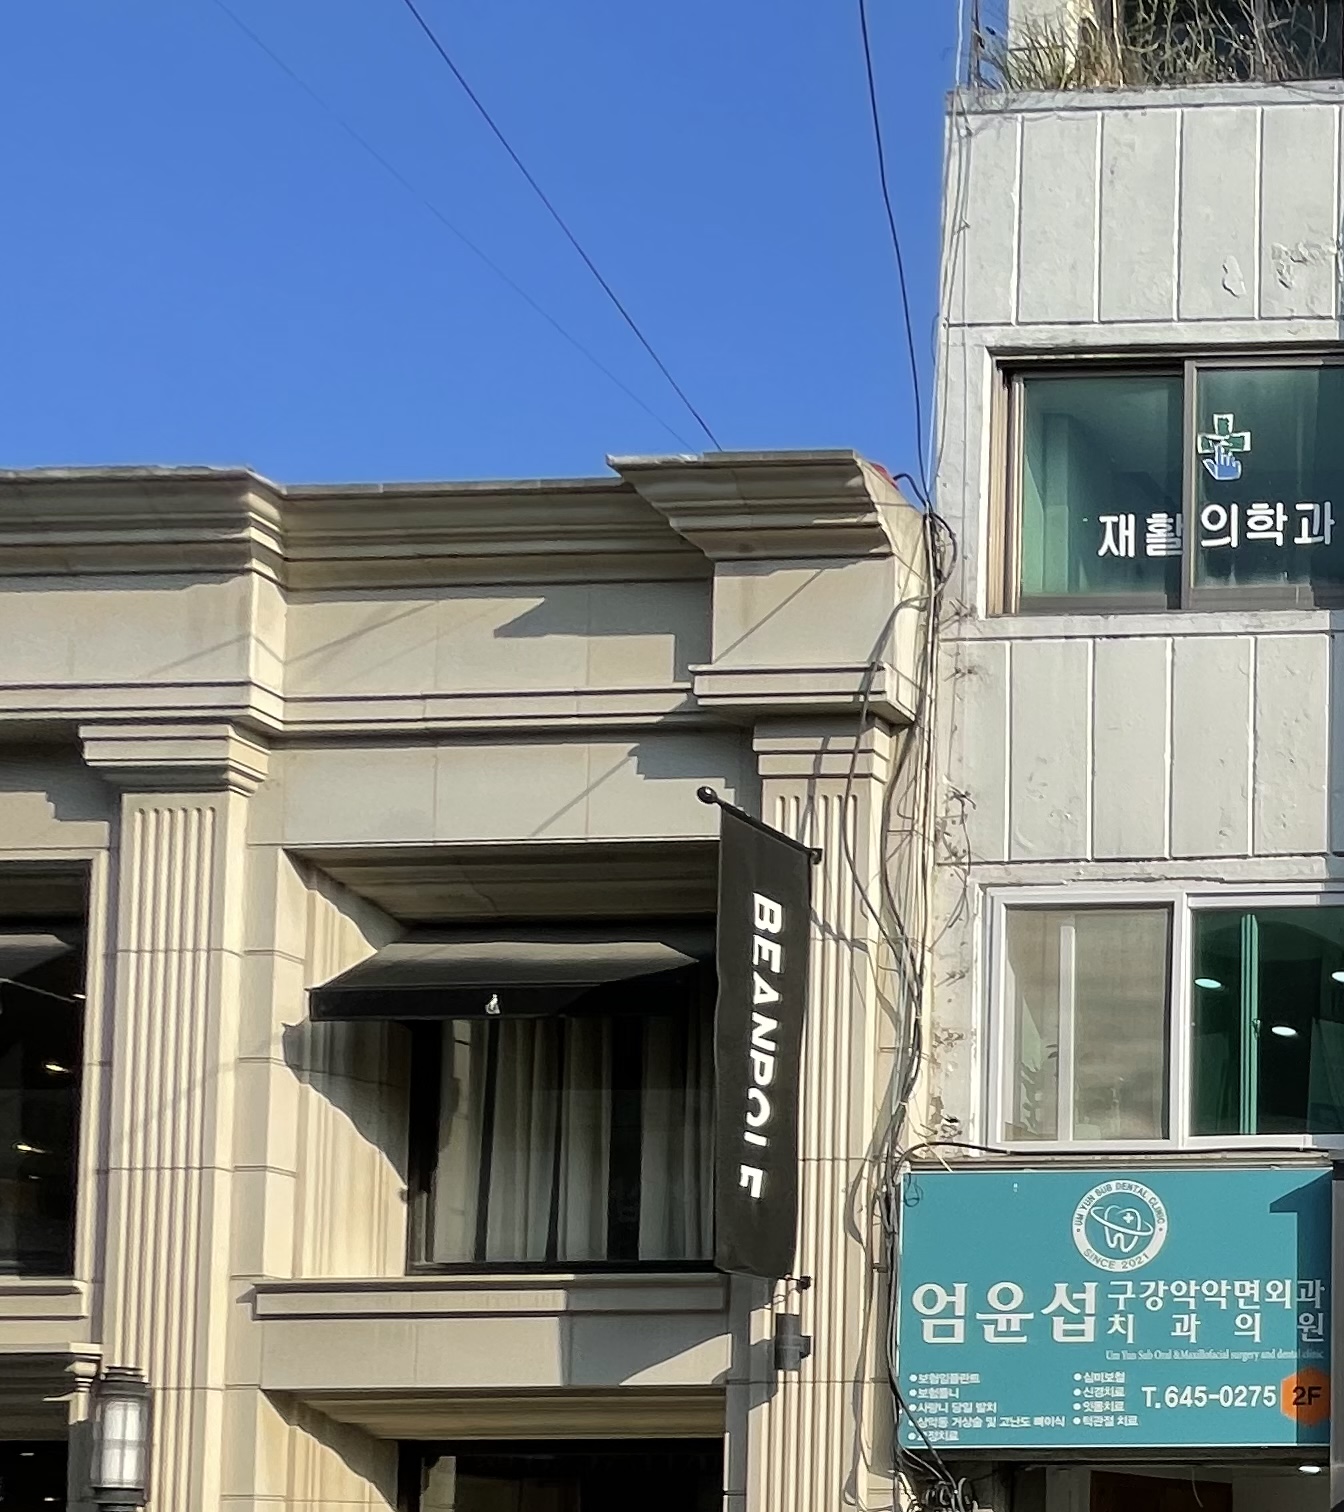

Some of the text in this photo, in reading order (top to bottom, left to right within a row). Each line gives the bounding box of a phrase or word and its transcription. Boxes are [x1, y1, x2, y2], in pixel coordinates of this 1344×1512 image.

[1097, 501, 1336, 558] 재활의학과
[1115, 1182, 1148, 1198] DENTAL
[1148, 1198, 1165, 1223] CLINIC
[1083, 1249, 1149, 1269] SINCE 2021
[911, 1280, 1099, 1345] 엄윤섭
[1106, 1312, 1324, 1344] 치과의원
[1231, 1351, 1259, 1363] surgery
[1261, 1350, 1276, 1360] and
[917, 1402, 997, 1414] 사랑니 당일 발치
[1292, 1386, 1322, 1406] 2F
